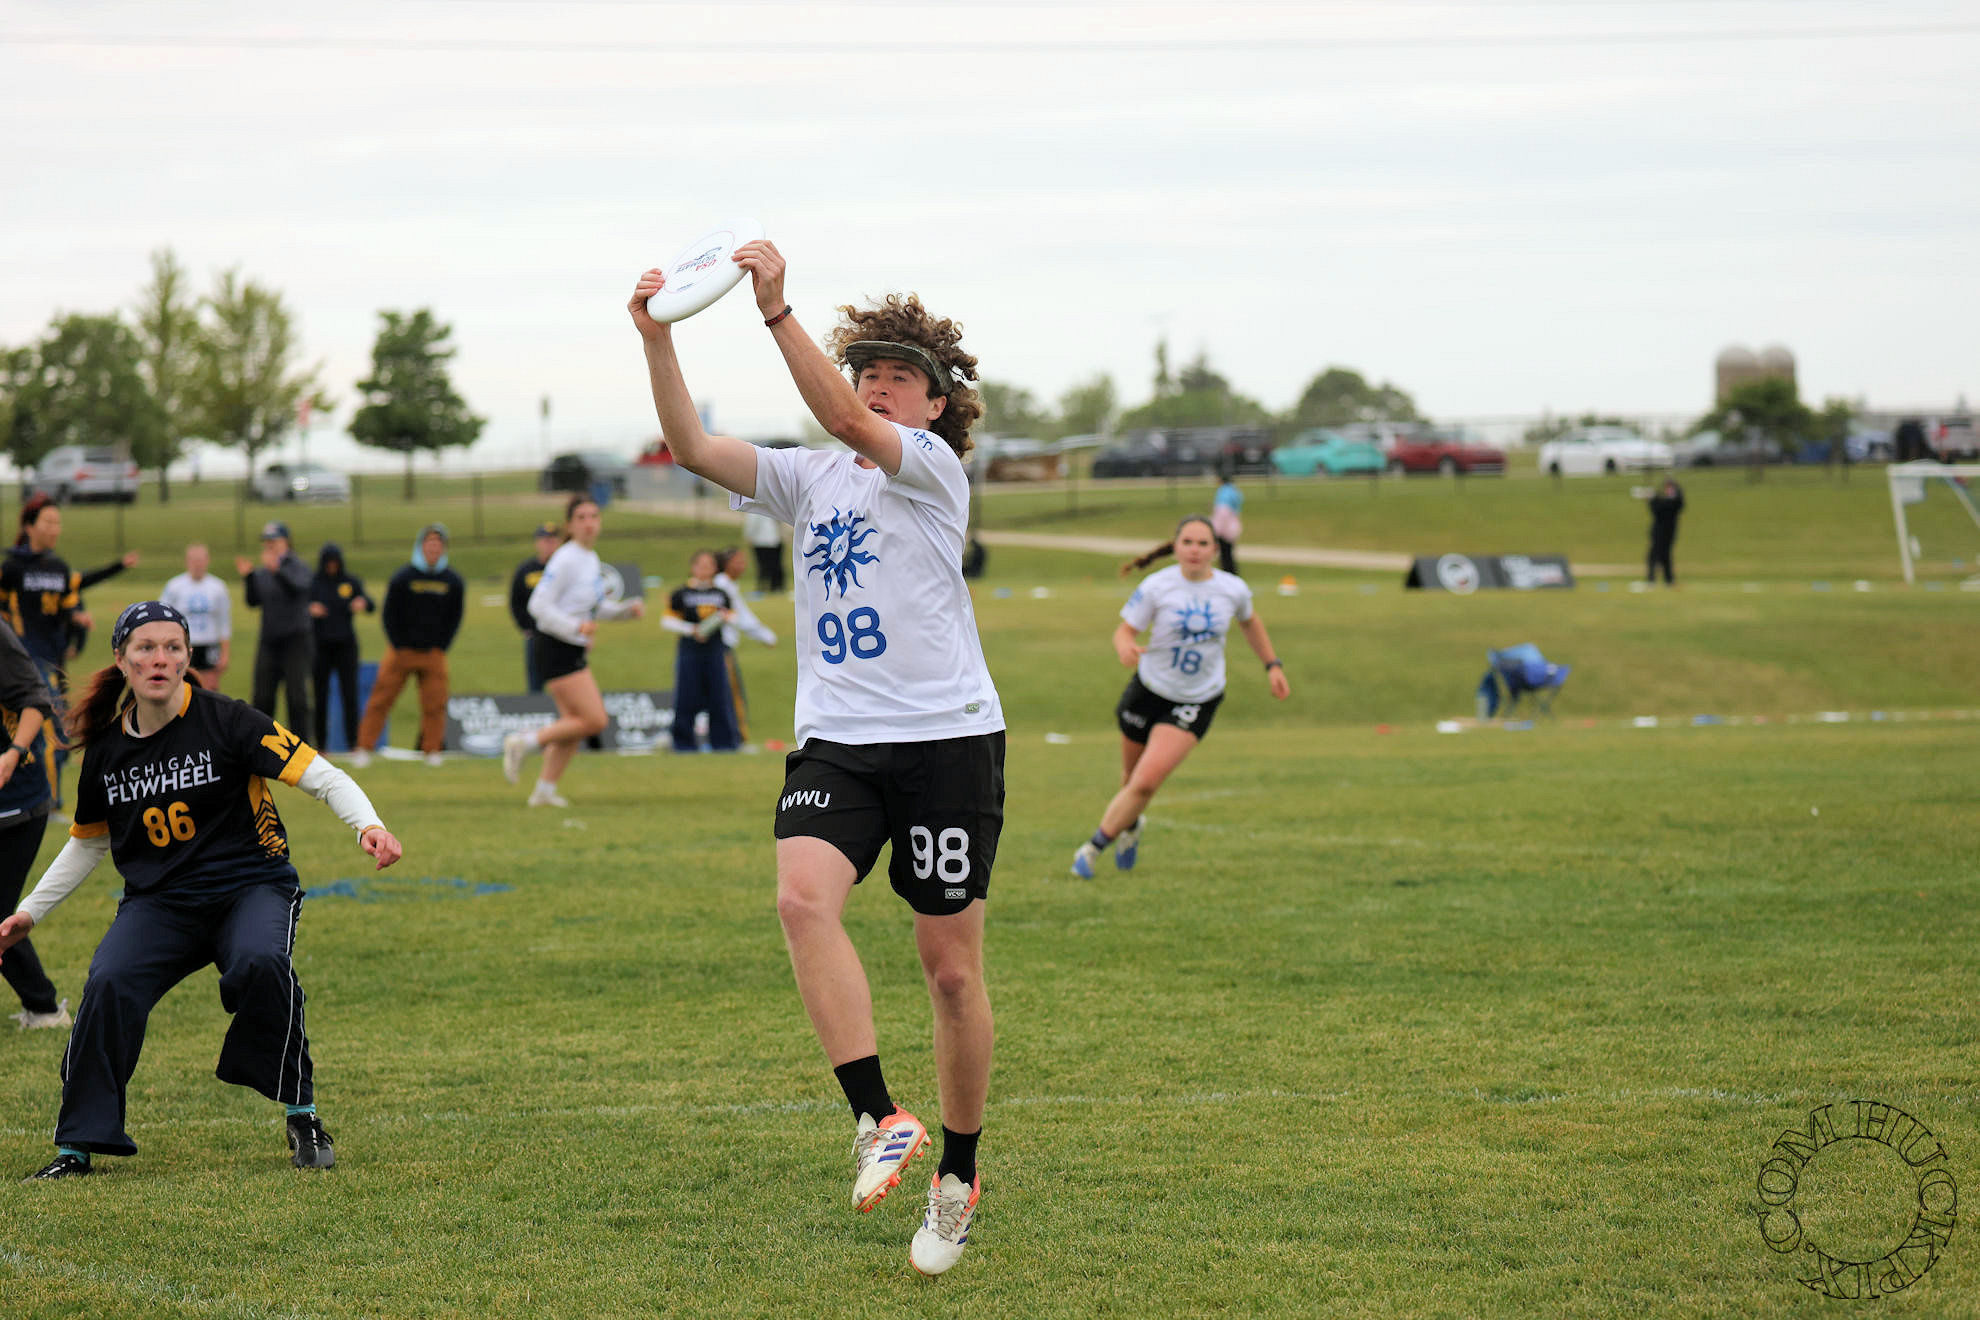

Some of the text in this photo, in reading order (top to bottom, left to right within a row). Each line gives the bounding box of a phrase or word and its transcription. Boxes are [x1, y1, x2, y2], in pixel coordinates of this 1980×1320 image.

[817, 606, 887, 665] 98
[1172, 647, 1202, 675] 18
[260, 720, 301, 762] M
[103, 749, 212, 788] MICHIGAN
[106, 762, 221, 806] FLYWHEEL
[781, 790, 831, 812] WWU
[142, 800, 196, 848] 86
[910, 825, 971, 883] 98
